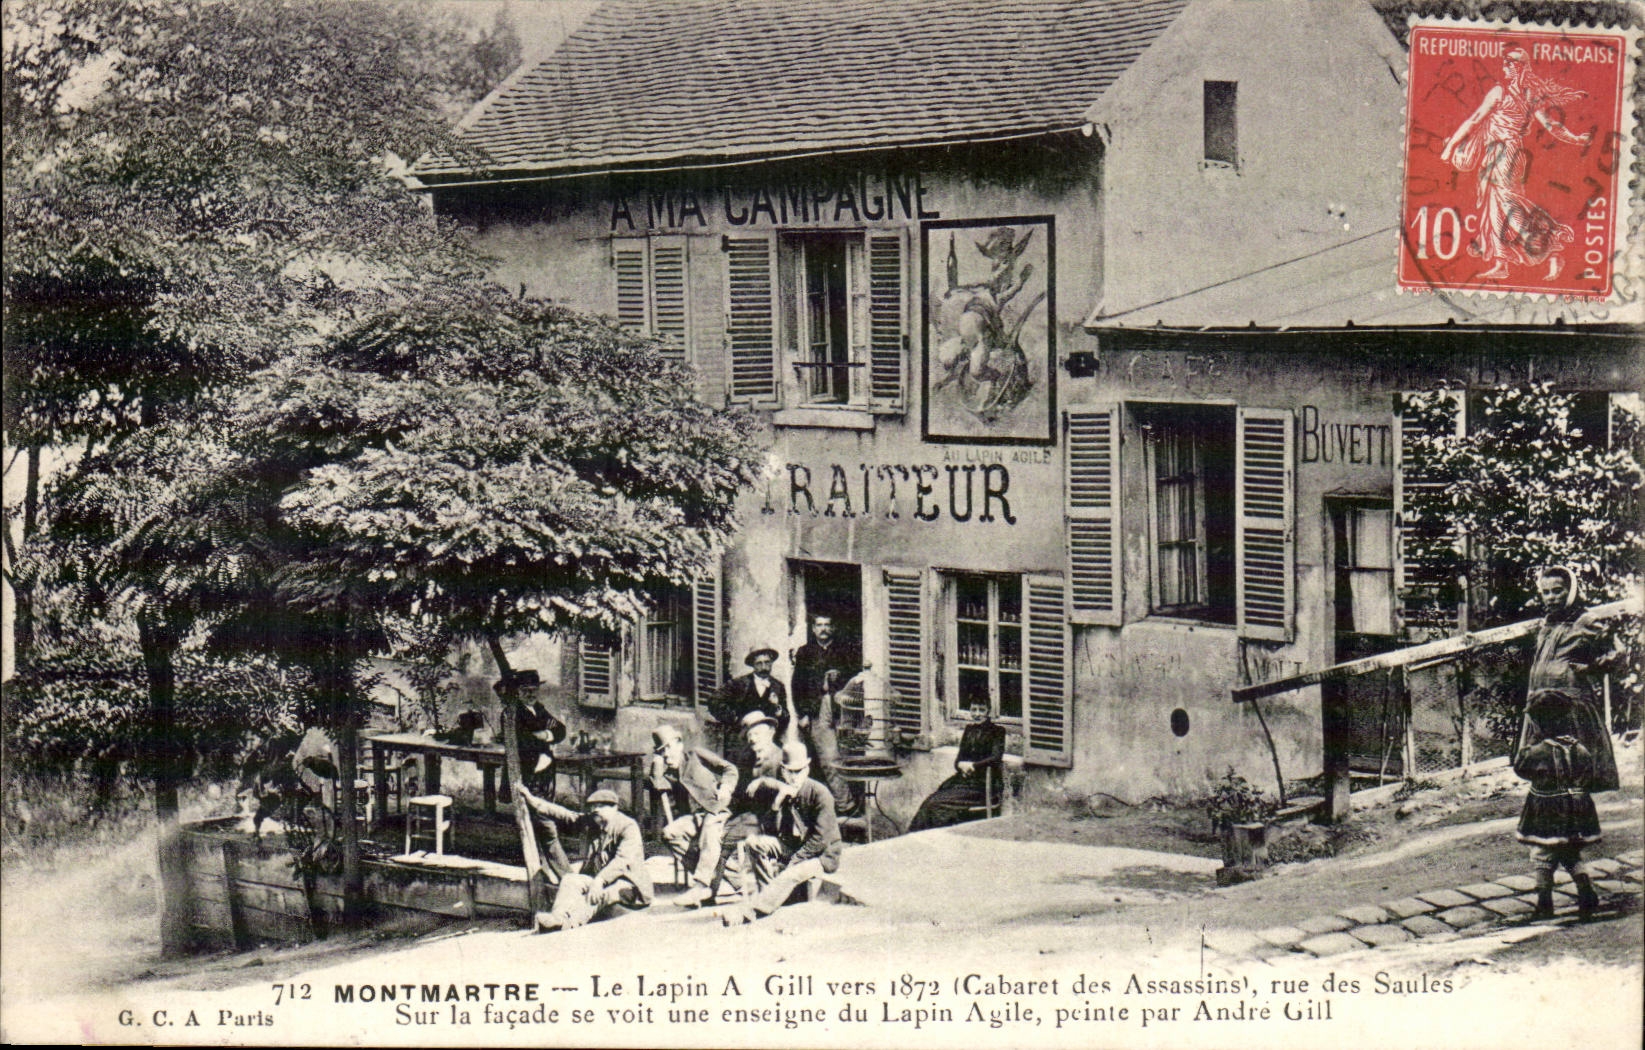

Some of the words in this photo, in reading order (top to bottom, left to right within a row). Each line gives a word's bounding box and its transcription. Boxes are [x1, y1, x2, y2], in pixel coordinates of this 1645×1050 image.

[1533, 43, 1615, 64] FRANÇAISE
[610, 187, 636, 231] A
[648, 184, 707, 229] MA
[724, 170, 941, 227] CAMPAGNE
[1583, 197, 1607, 279] POSTES
[1012, 447, 1052, 465] AGILE
[1301, 404, 1393, 467] BUVETT
